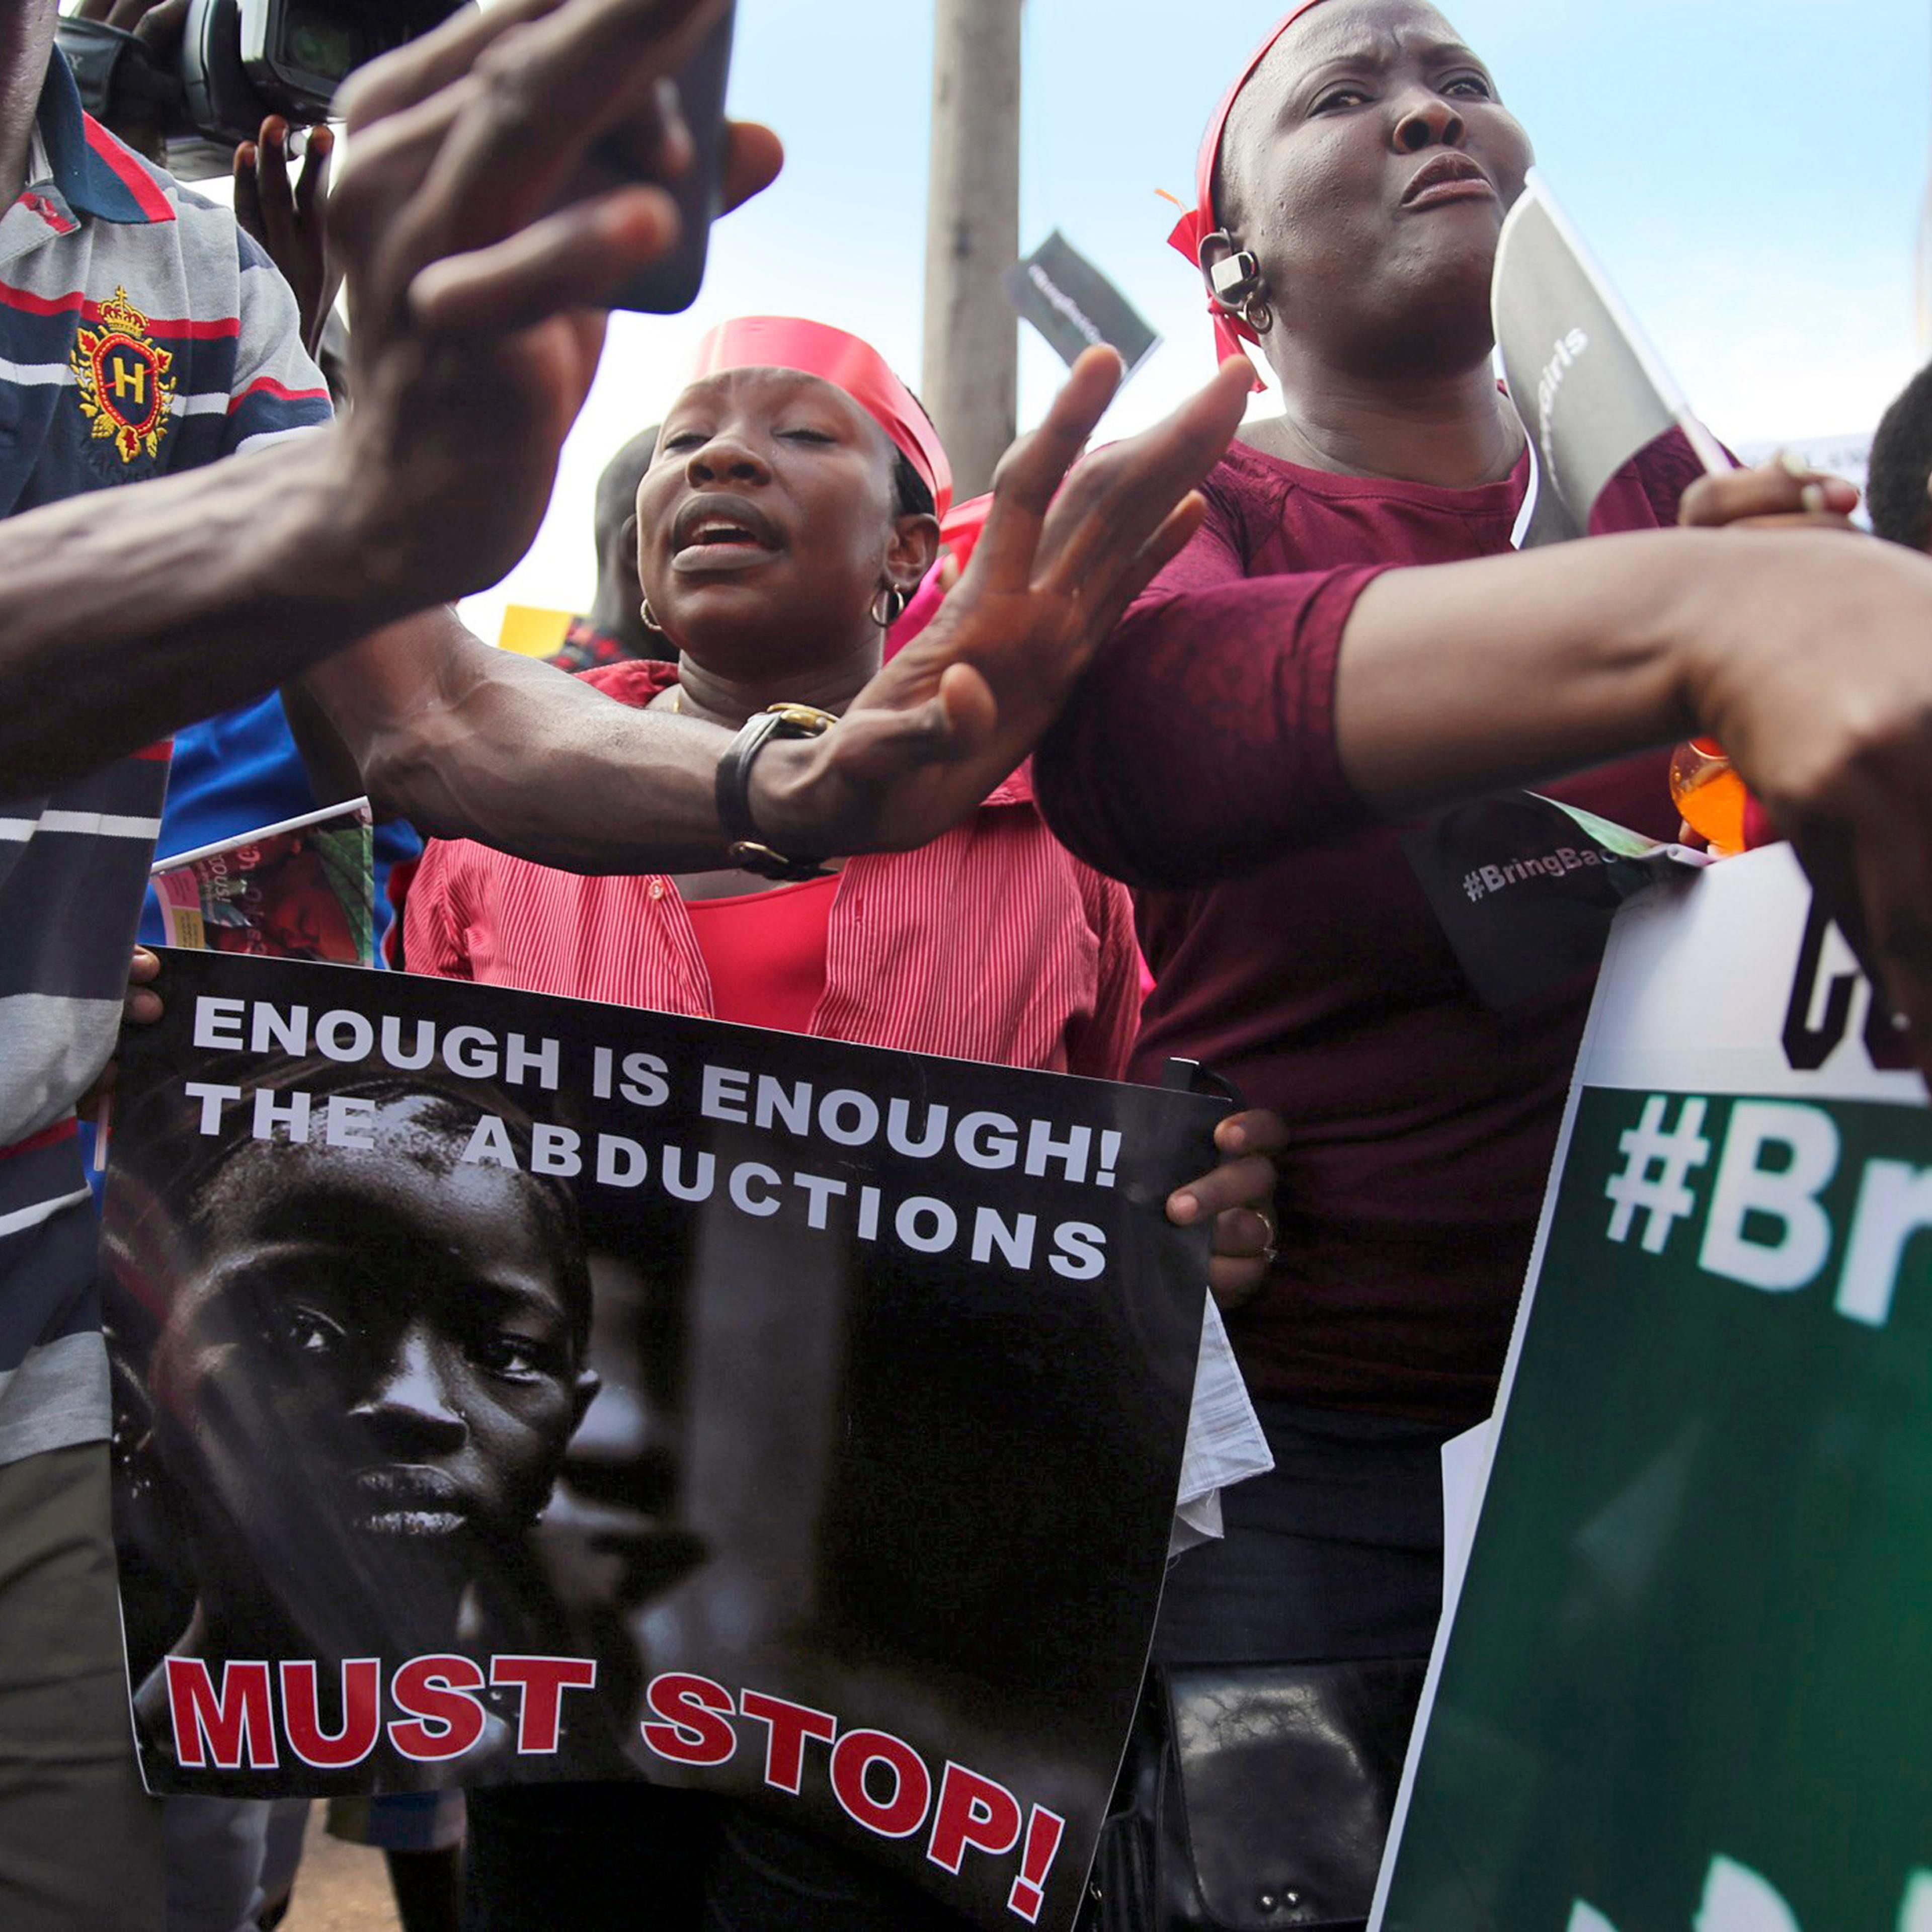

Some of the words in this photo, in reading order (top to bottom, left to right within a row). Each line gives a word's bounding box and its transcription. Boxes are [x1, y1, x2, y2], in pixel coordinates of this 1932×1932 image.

[113, 357, 144, 403] H
[185, 1082, 376, 1150] THE
[460, 1114, 1107, 1280] ABDUCTIONS
[193, 996, 559, 1090] ENOUGH
[593, 1046, 669, 1106] IS
[701, 1064, 1121, 1188] ENOUGH!
[1605, 1095, 1932, 1328] #Br
[164, 1653, 597, 1769] MUST
[640, 1672, 1065, 1925] STOP!
